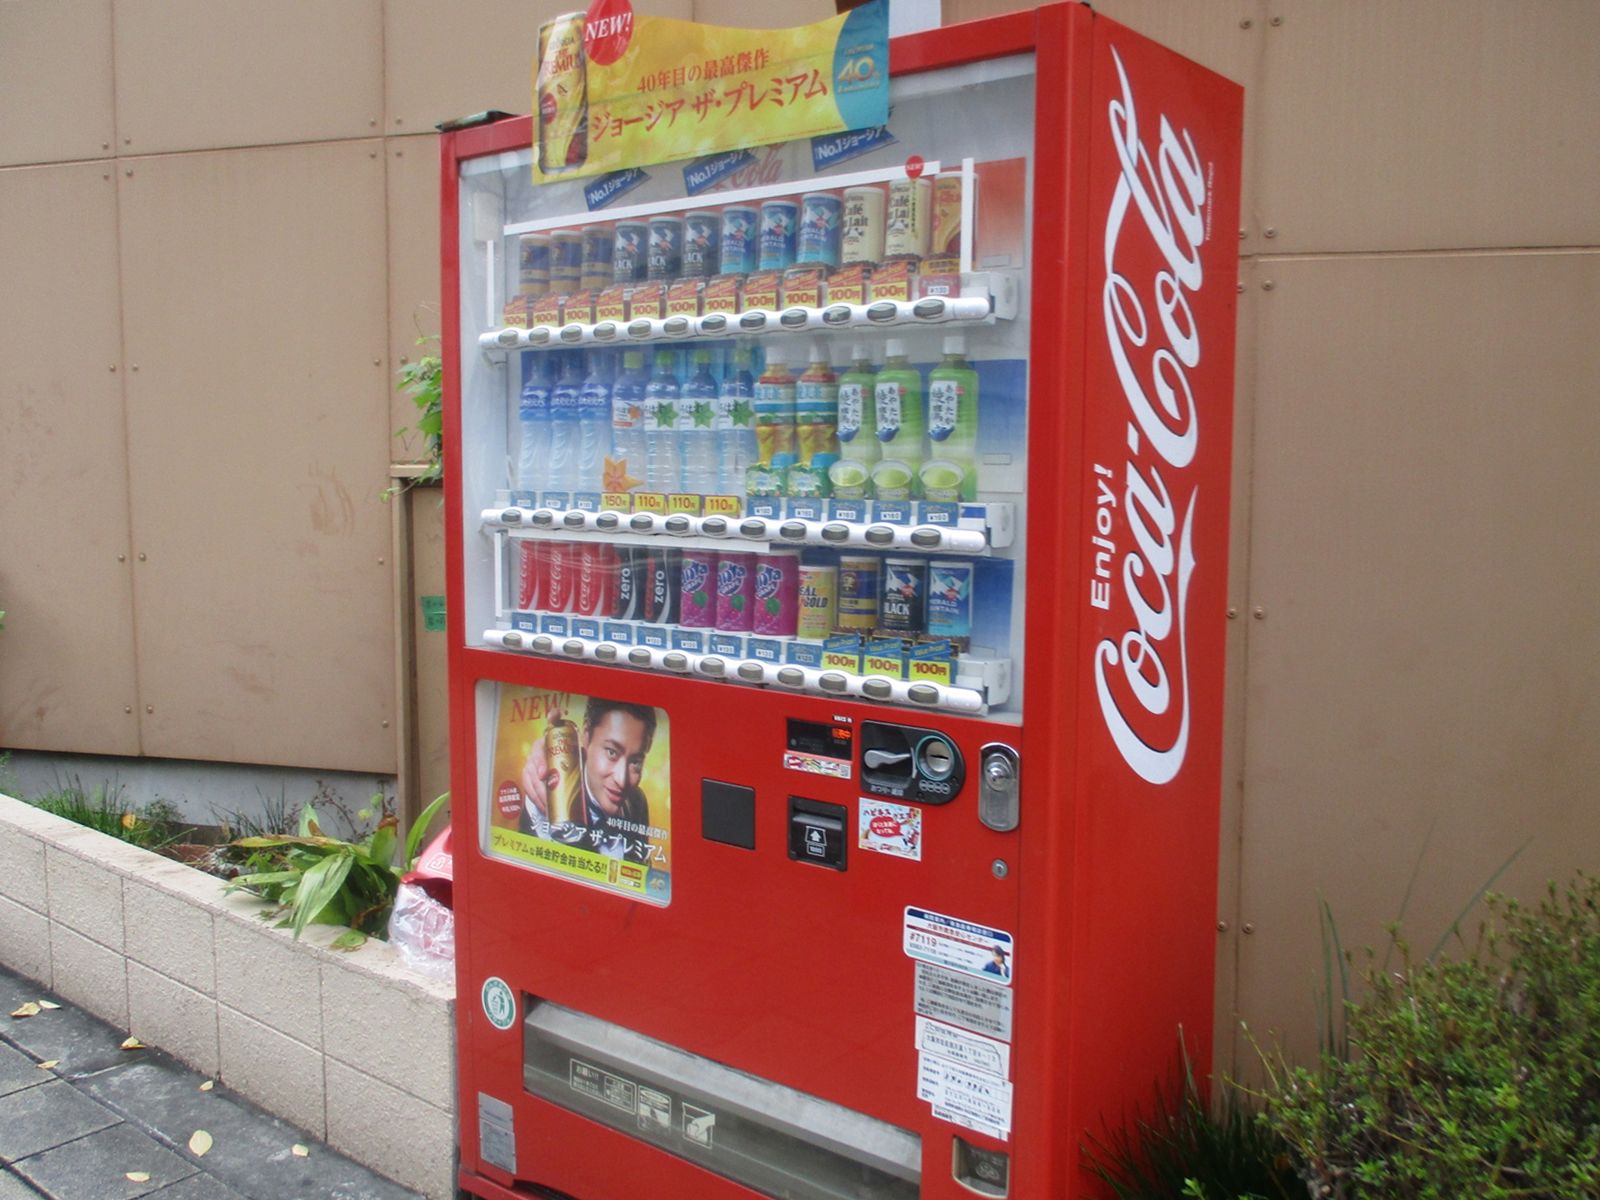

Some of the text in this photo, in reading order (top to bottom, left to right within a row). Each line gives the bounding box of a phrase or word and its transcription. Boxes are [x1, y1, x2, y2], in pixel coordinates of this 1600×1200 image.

[584, 12, 632, 42] NEW!
[636, 49, 770, 94] 40年目の最高傑作
[592, 69, 829, 143] ジョージア ザ・プレミアム
[1094, 43, 1206, 785] Coca-Cola
[1090, 463, 1118, 611] Enjoy!
[620, 567, 631, 600] zero
[654, 570, 665, 603] zero
[825, 654, 856, 668] 100円
[867, 658, 899, 672] 100円
[913, 662, 947, 676] 100円
[530, 820, 667, 864] ジョージア ザ・プレミアム
[606, 816, 668, 840] 40年目の最高傑作
[909, 932, 938, 947] #7119
